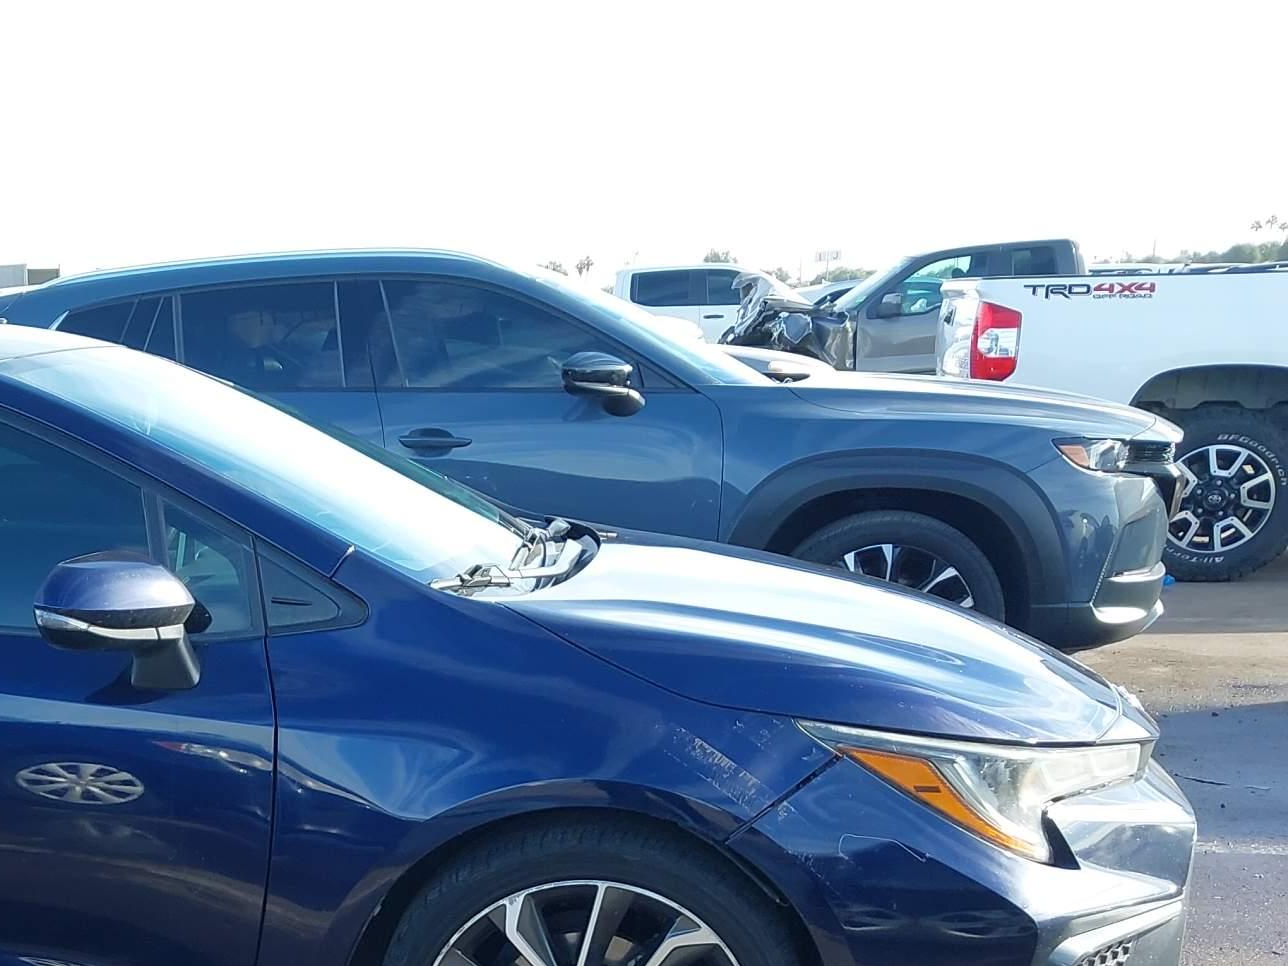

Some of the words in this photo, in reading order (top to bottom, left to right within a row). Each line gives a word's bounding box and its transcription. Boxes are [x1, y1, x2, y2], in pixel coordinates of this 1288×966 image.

[1024, 283, 1092, 299] TRD
[1093, 282, 1156, 294] 4X4
[1165, 544, 1224, 563] All-Terr
